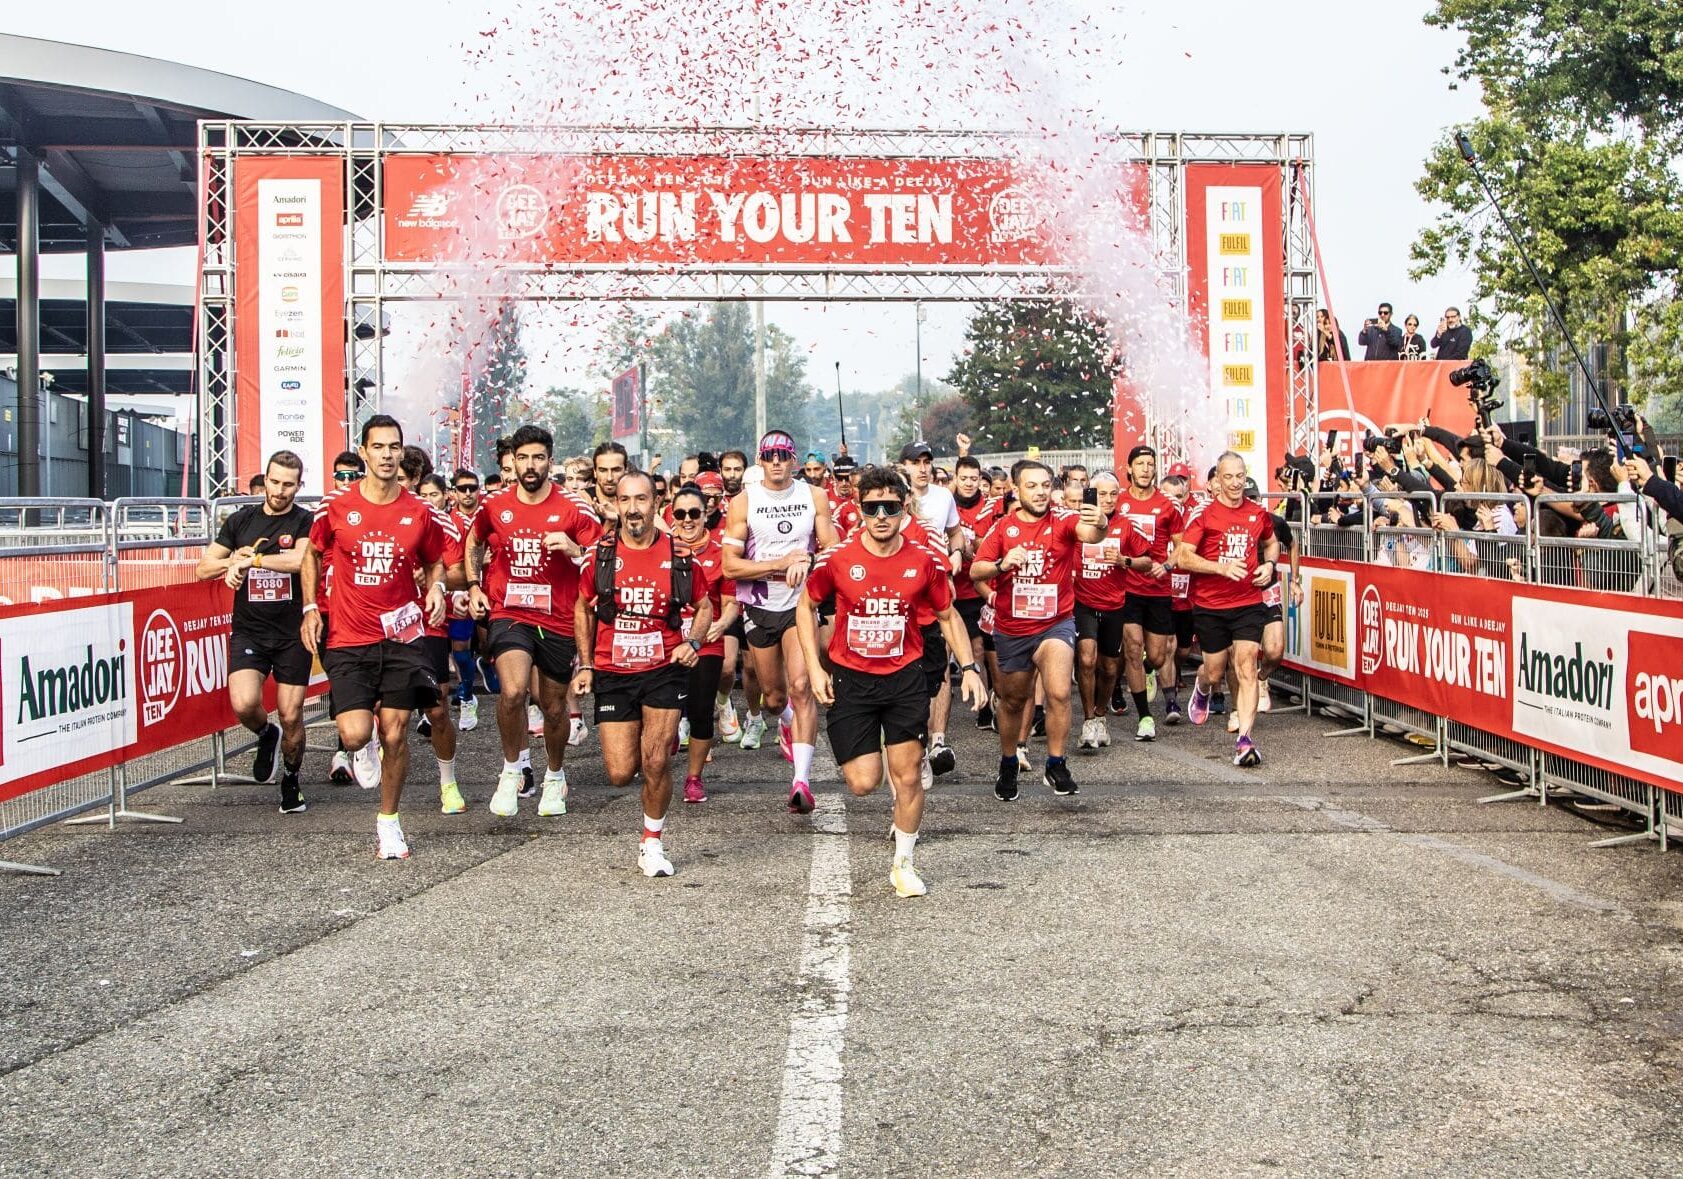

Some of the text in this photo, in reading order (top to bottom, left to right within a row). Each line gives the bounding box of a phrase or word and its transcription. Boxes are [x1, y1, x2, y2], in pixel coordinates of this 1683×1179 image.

[801, 176, 832, 187] RUN
[894, 176, 952, 188] DEEJAY
[273, 195, 306, 203] Amadori
[398, 220, 419, 228] new
[587, 191, 952, 243] RUN YOUR TEN
[1222, 237, 1248, 249] FULFIL
[1224, 302, 1249, 315] FULFIL
[756, 503, 808, 514] RUNNERS
[513, 538, 542, 553] DEE
[1227, 534, 1248, 546] DEE
[362, 541, 395, 558] DEE
[1225, 545, 1247, 558] JAY
[362, 558, 394, 574] JAY
[515, 553, 542, 567] JAY
[514, 568, 530, 576] TEN
[1018, 563, 1044, 577] JAY
[256, 579, 284, 589] 5080
[357, 575, 377, 584] TEN
[520, 594, 535, 605] 20
[620, 587, 654, 604] DEE
[866, 598, 899, 615] DEE
[1363, 600, 1379, 628] DEE
[183, 613, 234, 633] DEEJAY TEN 202
[619, 621, 637, 629] TEN
[1463, 615, 1478, 628] LIKE
[858, 630, 894, 642] 5930
[147, 627, 175, 663] DEE
[621, 645, 655, 658] 7985
[1385, 617, 1506, 699] RUN YOUR TEN
[185, 633, 228, 698] RUN
[1363, 659, 1373, 672] EN
[1518, 632, 1614, 711] Amadori
[17, 638, 127, 725] Amadori
[148, 661, 176, 697] JAY
[1634, 671, 1683, 735] apr
[145, 703, 162, 721] TEN
[1544, 705, 1553, 715] THE
[1554, 707, 1574, 718] ITALIAN
[1574, 711, 1594, 724] PROTEIN
[59, 723, 71, 733] THE
[71, 719, 87, 732] ITALIAN
[87, 714, 105, 725] PROTEIN
